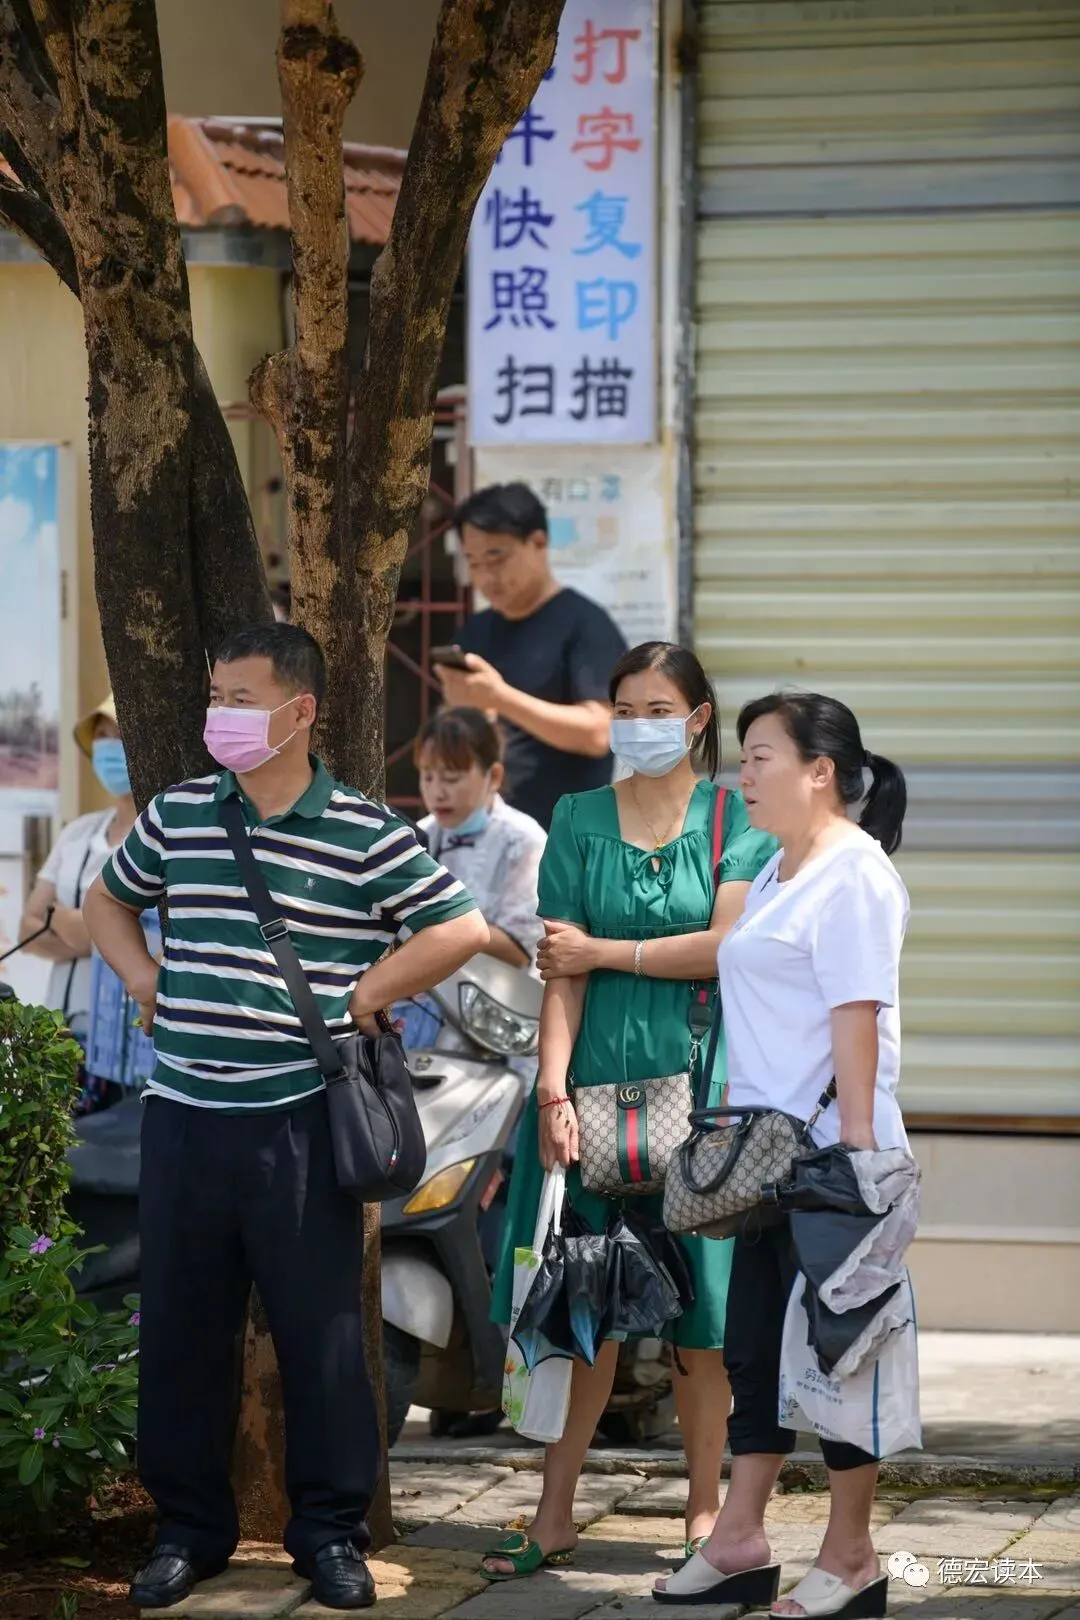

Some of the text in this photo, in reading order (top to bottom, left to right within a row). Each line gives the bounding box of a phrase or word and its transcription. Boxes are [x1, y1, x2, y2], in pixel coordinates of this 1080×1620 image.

[483, 66, 558, 331] 件快照
[570, 19, 643, 342] 打字复印
[493, 354, 634, 425] 扫描
[514, 473, 621, 503] 有口罩
